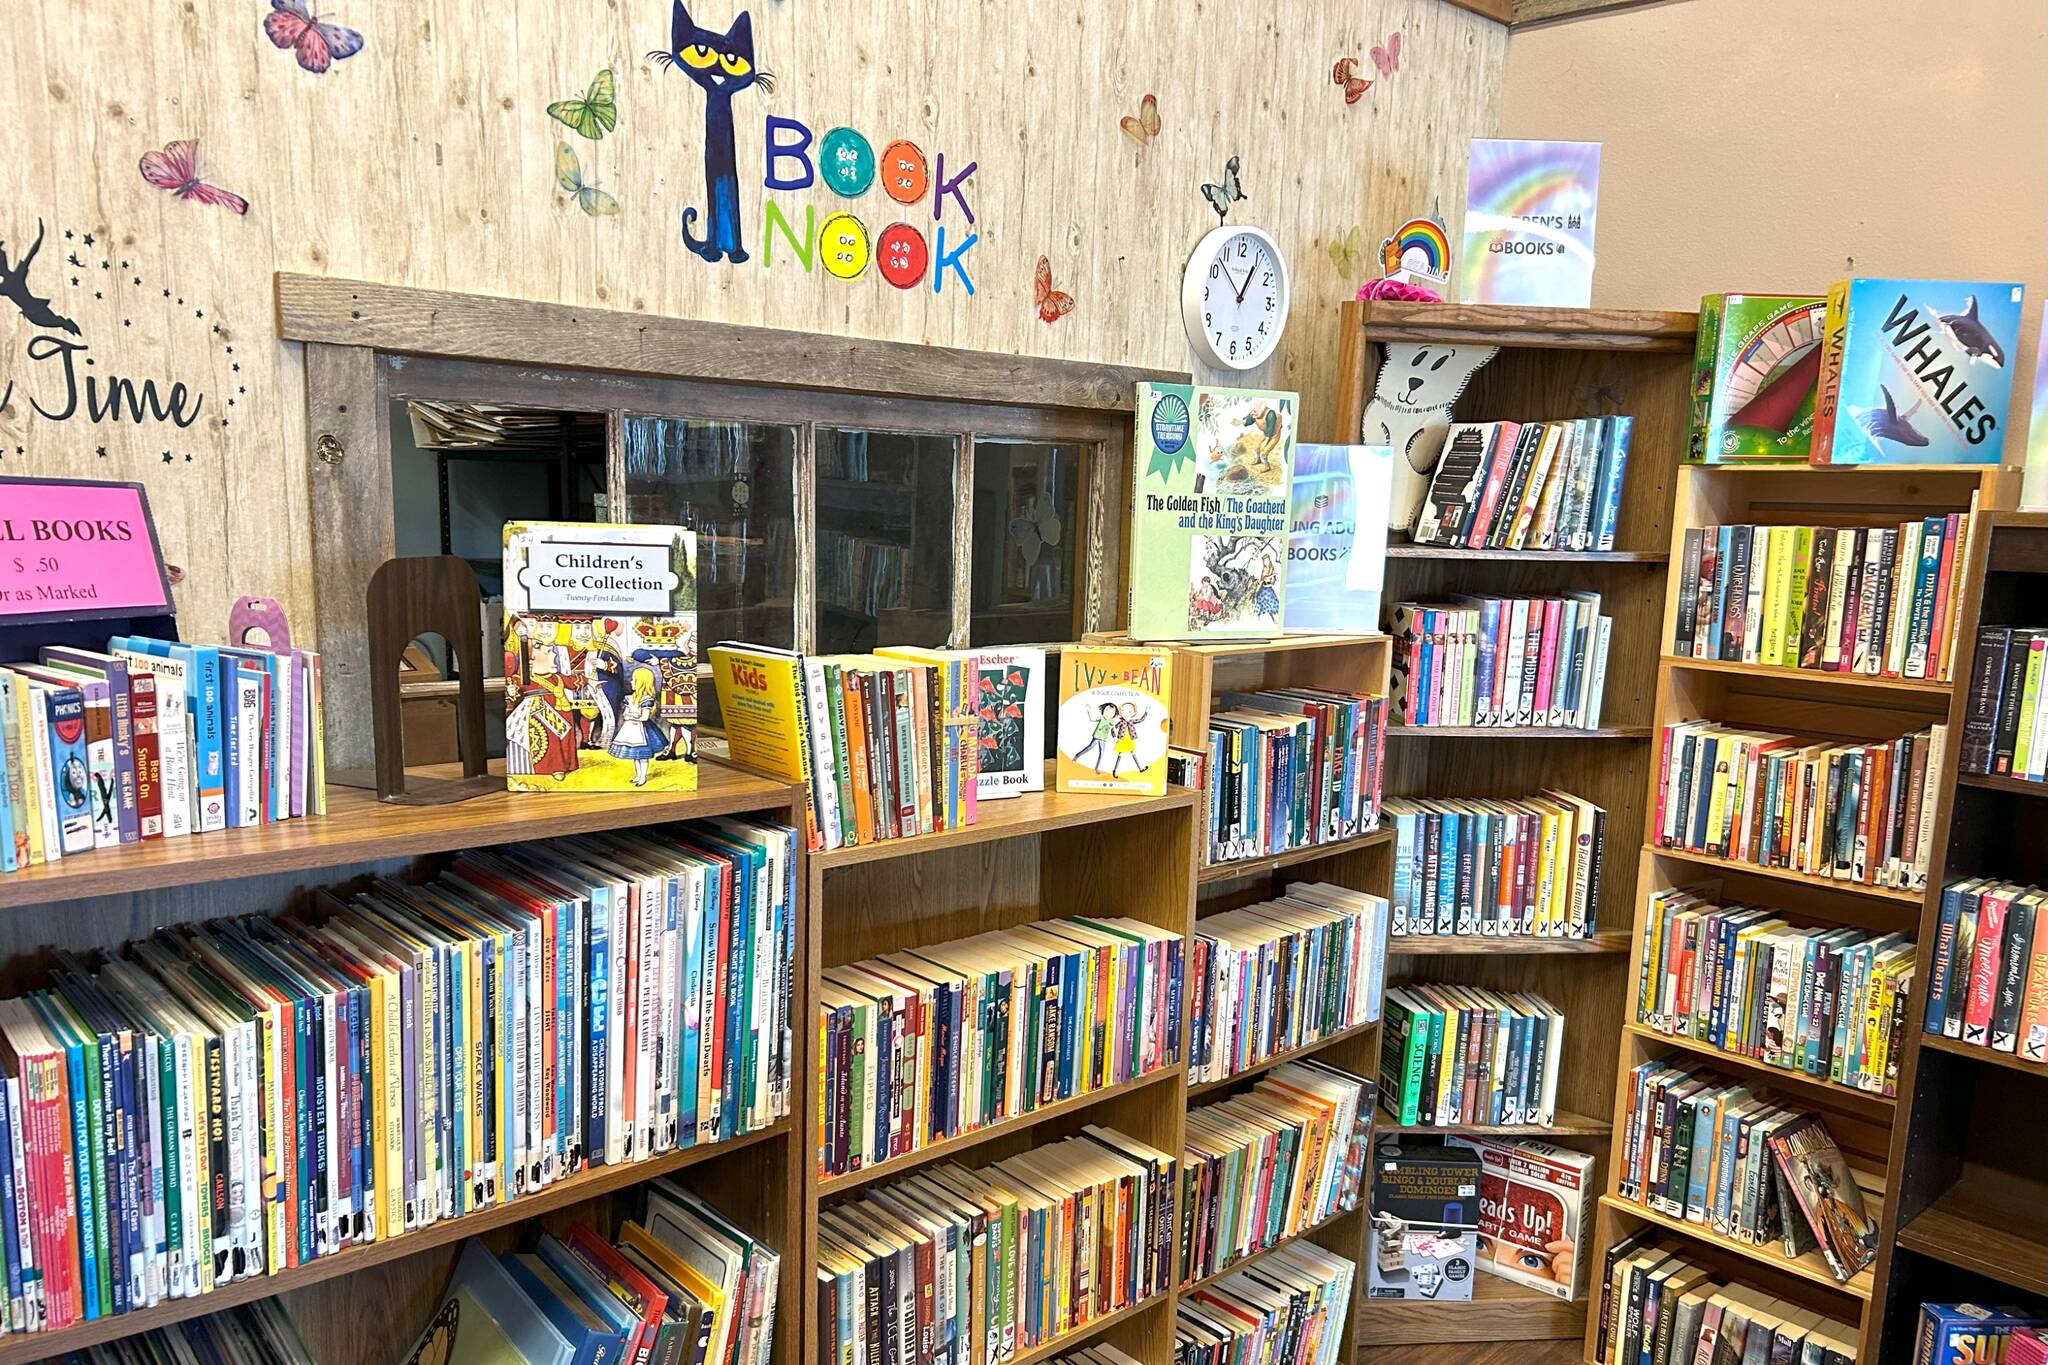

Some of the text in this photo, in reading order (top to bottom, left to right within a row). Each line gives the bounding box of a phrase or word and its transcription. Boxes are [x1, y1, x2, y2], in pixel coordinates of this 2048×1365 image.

[764, 114, 978, 225] BOOK
[763, 199, 979, 297] NOOK
[1223, 247, 1230, 263] 11
[1237, 242, 1247, 258] 12
[1255, 252, 1259, 267] 1
[1504, 242, 1554, 255] BOOKS
[1209, 264, 1219, 280] 10
[1262, 272, 1269, 287] 2
[1265, 297, 1272, 312] 3
[1215, 331, 1222, 347] 7
[1245, 336, 1252, 351] 5
[1257, 321, 1265, 336] 4
[1723, 301, 1796, 370] THE GRAPE GAME
[1230, 340, 1237, 355] 6
[27, 335, 204, 429] Time
[1822, 326, 1845, 418] WHALES
[1880, 293, 1997, 446] WHALES
[1776, 434, 1788, 446] To
[1786, 424, 1801, 439] the
[1146, 493, 1164, 512] The
[1166, 495, 1198, 512] Golden
[1200, 496, 1221, 513] Fish
[1227, 497, 1244, 514] The
[1245, 498, 1286, 515] Goatherd
[0, 519, 133, 541] L BOOKS
[1178, 513, 1285, 534] and the King's Daughter
[36, 557, 60, 573] .50
[555, 553, 644, 570] Children's
[1288, 547, 1338, 562] BOOKS
[15, 590, 33, 601] as
[36, 583, 99, 601] Marked
[538, 574, 664, 591] Core Collection
[1730, 564, 1746, 619] WITCHLINGS
[565, 593, 635, 603] Twenty-First Edition
[979, 654, 1015, 665] Escher
[1522, 630, 1540, 693] THE MIDDLE
[730, 662, 769, 692] Kids
[55, 702, 81, 717] PHONICS
[204, 661, 216, 740] first 100 animals
[115, 692, 133, 811] Little Husky's BIG GAME
[960, 739, 968, 772] CHARLIE
[967, 736, 977, 780] MATILDA
[138, 747, 150, 799] Snores On
[150, 759, 159, 783] Bear
[977, 774, 1029, 787] zzle Book
[1332, 746, 1344, 792] FAKE ID
[1424, 854, 1437, 919] KITTY GRANGER
[1572, 847, 1589, 920] Radical Element
[640, 891, 653, 1053] GIANT TREASURY PETER RABBIT
[1933, 923, 1954, 1001] What Hearts
[689, 969, 699, 1007] Cinderella
[702, 922, 717, 1077] Snow White and the Seven Dwarfs
[1815, 971, 1826, 1002] DOG MAN
[1868, 977, 1881, 1011] Crush
[2027, 953, 2047, 1024] DEPARTURES
[405, 999, 414, 1029] Scratch
[598, 1038, 606, 1068] CHILLING
[1410, 1043, 1424, 1088] SCIENCE
[475, 1041, 483, 1117] SPACE WALKS
[533, 1006, 541, 1131] LIVES OF THE PRESIDENTS
[211, 1048, 223, 1141] WESTWARD HO!
[866, 1065, 875, 1110] FLIPPED
[315, 1076, 326, 1172] MONSTER TRUCKS!
[166, 1105, 177, 1188] THE GERMAN SHEPHERD
[1659, 1125, 1671, 1184] NAYRA DJINN
[1442, 1167, 1479, 1177] TOWER
[1511, 1166, 1529, 1175] GAMES
[1529, 1163, 1550, 1175] MILLION
[1556, 1177, 1577, 1188] EDITION
[1561, 1172, 1573, 1182] 4TH
[129, 1159, 139, 1232] The Seawolf Class
[215, 1172, 224, 1210] CARLSON
[1399, 1186, 1456, 1195] DOMINOES
[1479, 1197, 1552, 1235] eads Up!
[1477, 1219, 1542, 1246] ARTY GAME
[1609, 1288, 1620, 1344] ARTEMIS FOWL
[922, 1326, 930, 1354] Louise
[1656, 1308, 1670, 1364] ARTEMIS FOWL
